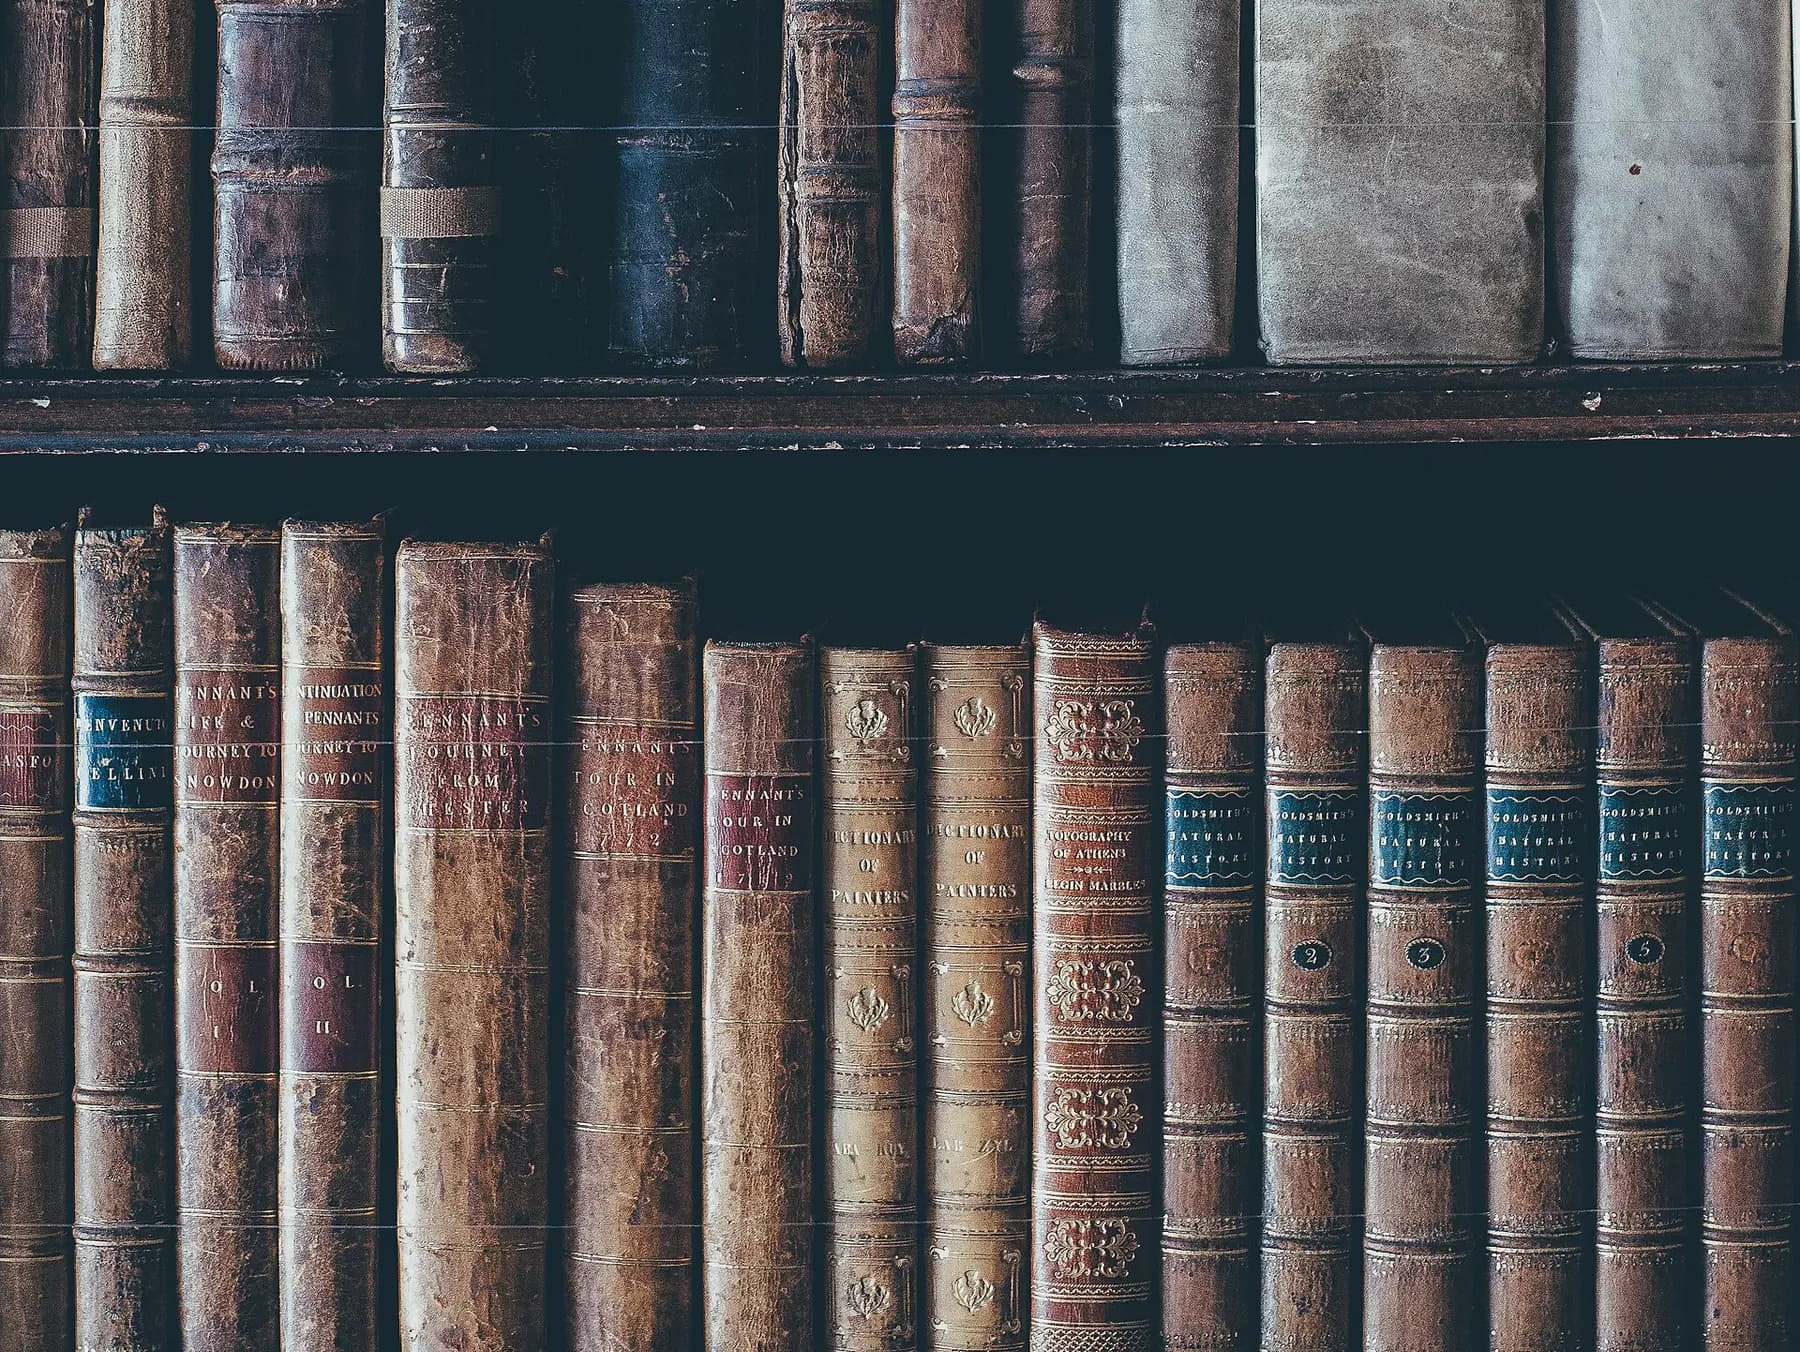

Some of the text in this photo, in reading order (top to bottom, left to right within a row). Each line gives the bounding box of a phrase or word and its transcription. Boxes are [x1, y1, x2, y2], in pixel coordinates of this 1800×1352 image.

[240, 715, 254, 728] &
[423, 707, 541, 727] ENNANT'S
[260, 745, 277, 758] TO
[91, 766, 167, 780] ELLINI
[296, 770, 374, 787] NOWDON
[572, 770, 676, 786] TOUR IN
[721, 784, 804, 801] ENNANT'S
[571, 802, 688, 817] COTLAND
[775, 814, 792, 827] IN
[1047, 830, 1132, 842] TOPOGRAPHY
[721, 844, 798, 857] COTLAND
[964, 850, 984, 865] OF
[1054, 848, 1126, 860] OF ATHENS
[859, 858, 878, 873] OF
[936, 882, 1017, 899] PAINTERS
[1045, 879, 1146, 892] ELGIN MARBLES
[832, 889, 909, 905] PAINTERS
[1305, 947, 1318, 965] 2
[1417, 946, 1431, 964] 3
